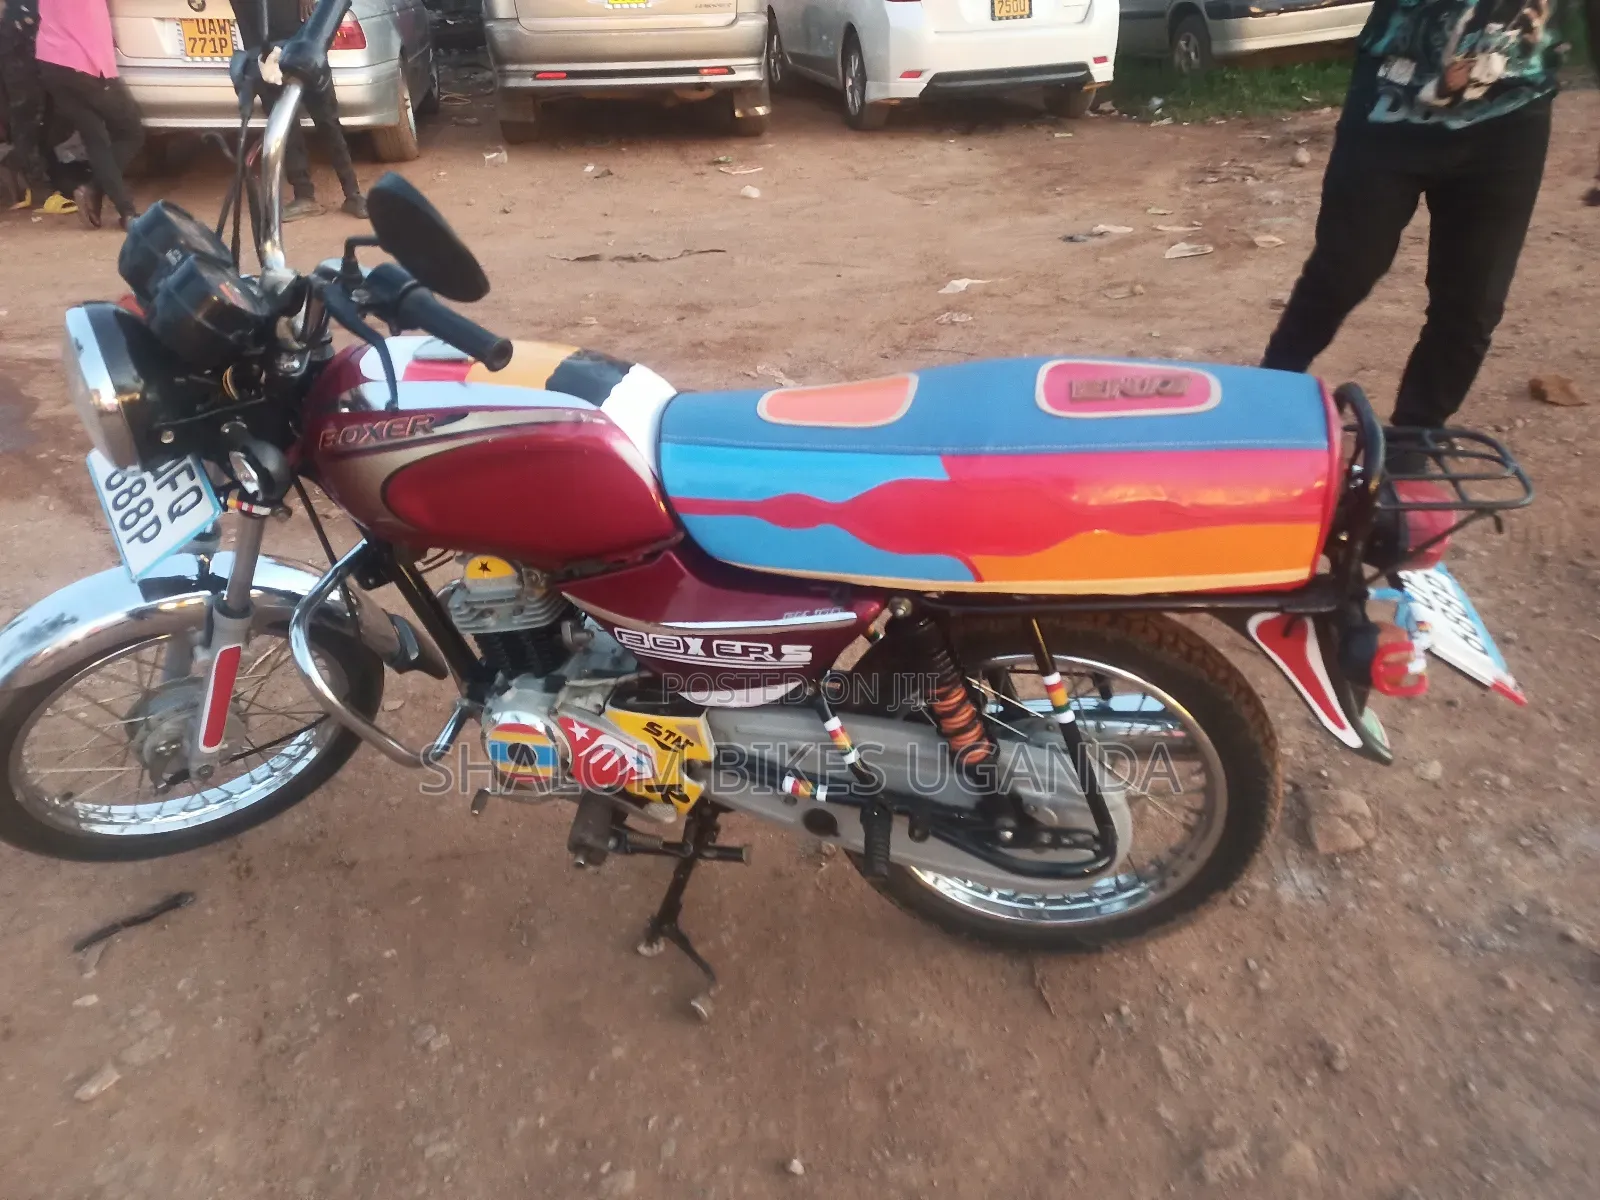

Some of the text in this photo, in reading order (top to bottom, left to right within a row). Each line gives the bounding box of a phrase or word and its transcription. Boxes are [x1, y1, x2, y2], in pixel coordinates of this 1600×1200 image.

[196, 19, 228, 35] UAW
[188, 37, 228, 53] 771P
[318, 413, 435, 450] BOXER
